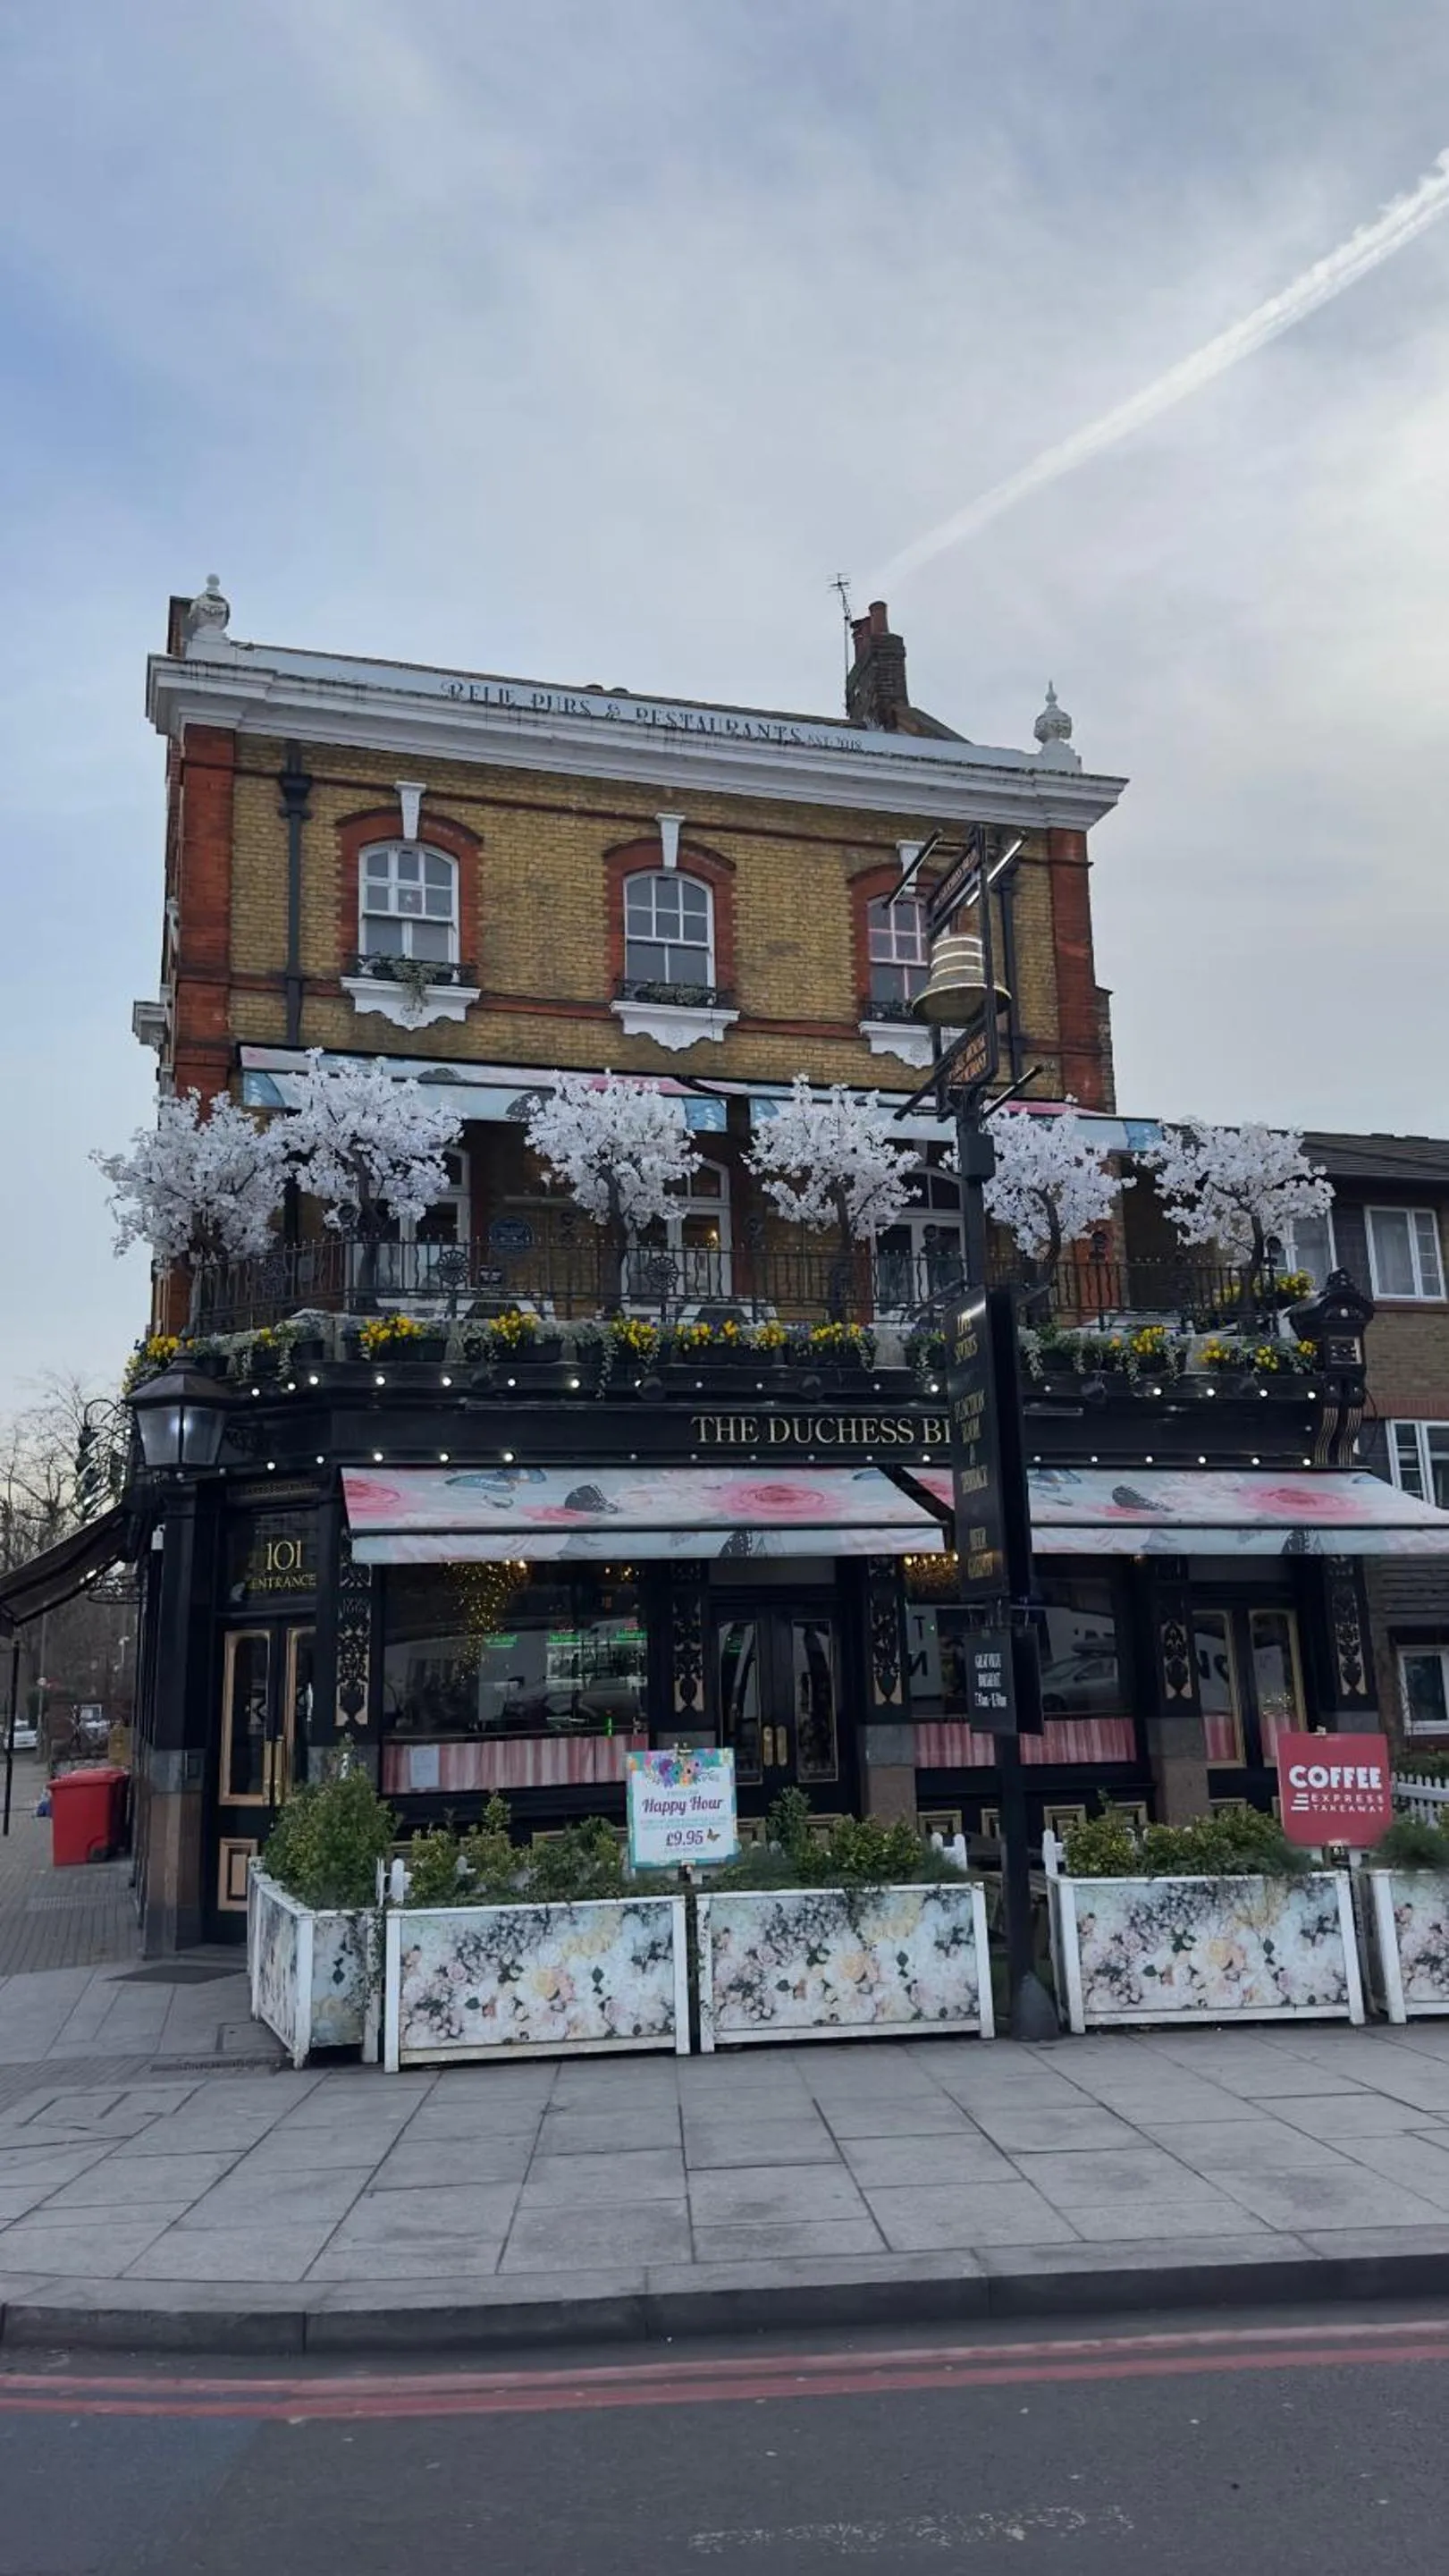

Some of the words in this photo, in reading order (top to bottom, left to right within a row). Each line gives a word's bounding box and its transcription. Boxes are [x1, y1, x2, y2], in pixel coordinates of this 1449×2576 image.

[636, 706, 802, 744] RESTAURANTS
[692, 1416, 759, 1443] THE
[768, 1417, 914, 1443] DUCHESS
[266, 1540, 302, 1571] 101
[250, 1574, 316, 1590] ENTRANCE
[1288, 1765, 1382, 1789] COFFEE
[642, 1798, 687, 1816] Happy
[689, 1795, 724, 1811] Hour
[1311, 1794, 1385, 1803] EXPRESS
[1312, 1804, 1385, 1812] TAKEAWAY
[666, 1829, 704, 1847] £9.95
